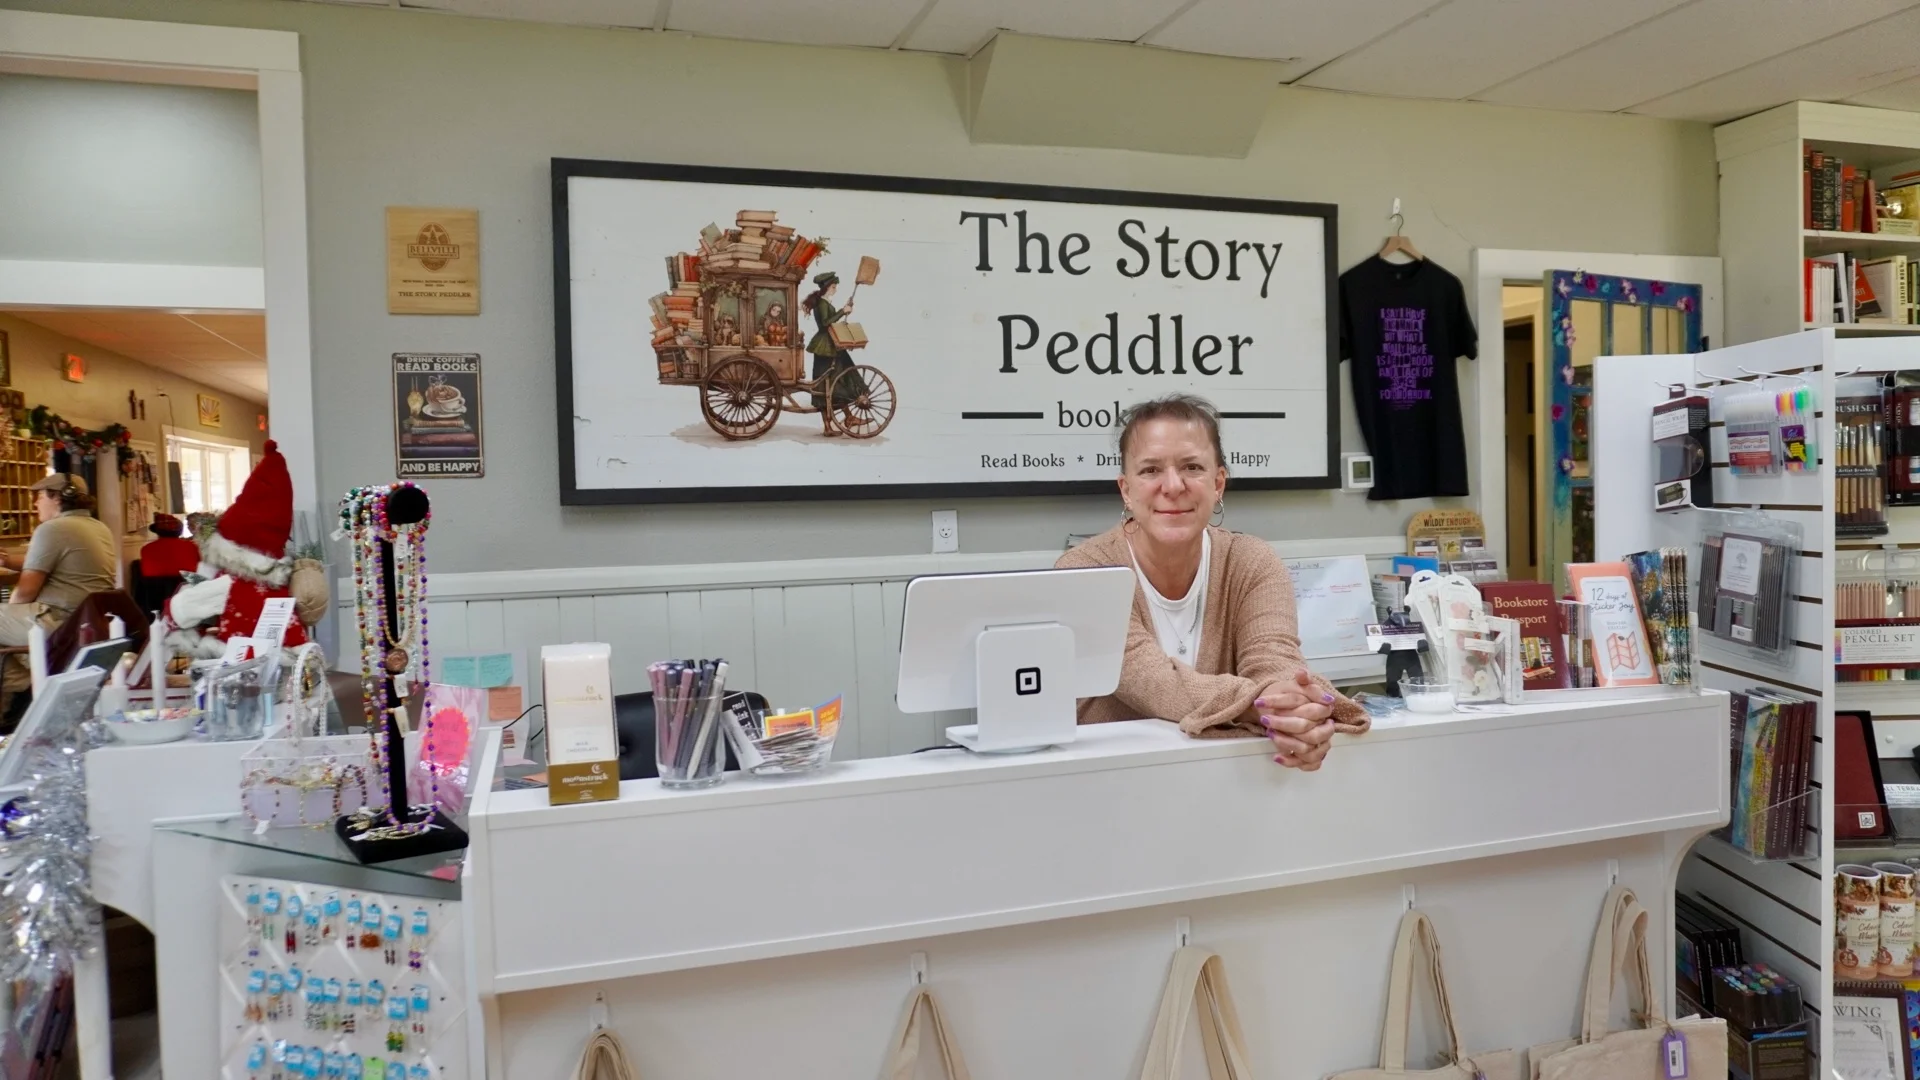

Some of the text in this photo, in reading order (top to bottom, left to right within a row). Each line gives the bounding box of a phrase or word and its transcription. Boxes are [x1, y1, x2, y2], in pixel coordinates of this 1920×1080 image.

[959, 209, 1283, 299] The Story
[997, 312, 1254, 376] Peddler
[397, 362, 477, 371] READ BOOKS
[1861, 403, 1878, 412] SET
[1057, 400, 1128, 428] book
[981, 453, 1018, 468] Read
[1022, 453, 1065, 468] Books
[1231, 451, 1271, 467] Happy
[401, 462, 479, 472] AND BE HAPPY
[1424, 517, 1472, 527] WILDLY ENOUGH
[1591, 587, 1604, 601] 12
[1493, 596, 1549, 608] Bookstore
[1500, 613, 1547, 628] Psport
[1844, 633, 1916, 644] PENCIL SET
[562, 772, 608, 783] moonstruck
